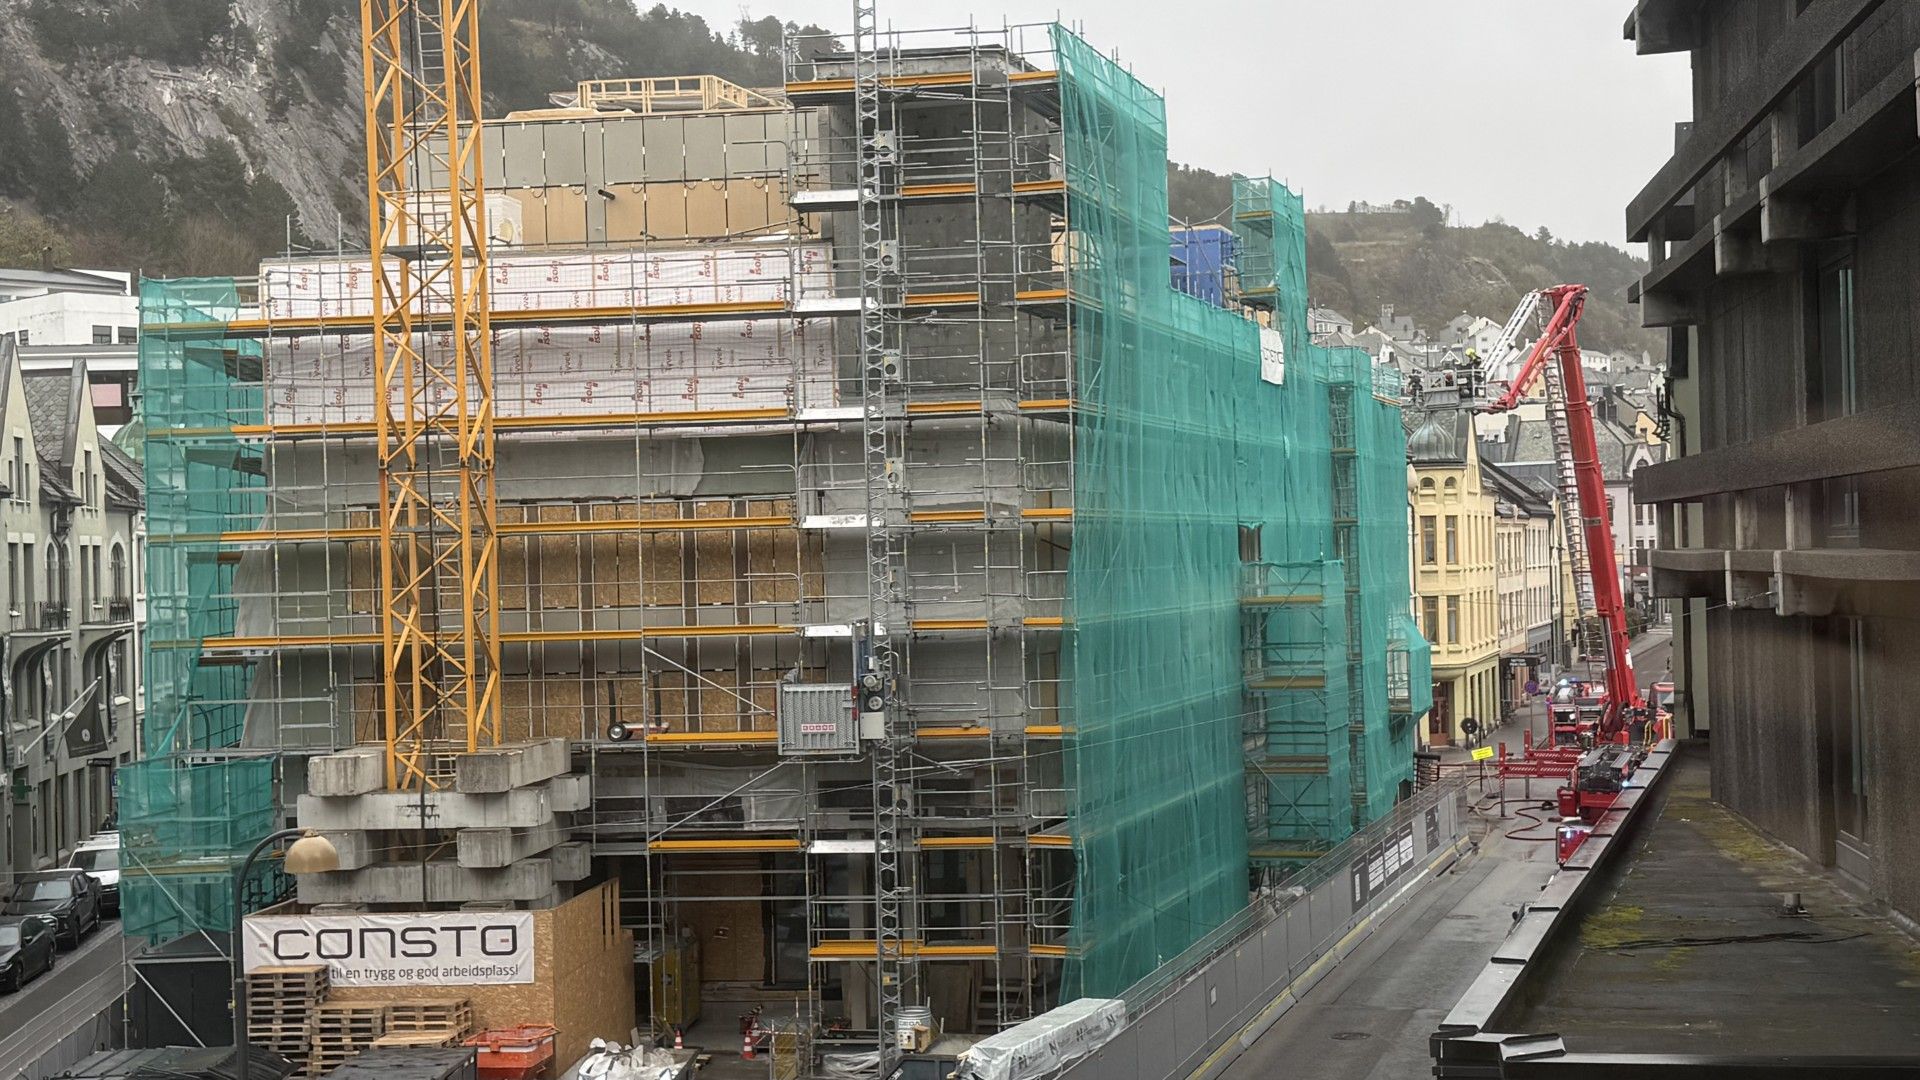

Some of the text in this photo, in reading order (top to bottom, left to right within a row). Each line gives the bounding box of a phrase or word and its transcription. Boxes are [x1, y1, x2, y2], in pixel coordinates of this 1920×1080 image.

[331, 964, 519, 981] til en trygg og god arbeidsplass!
